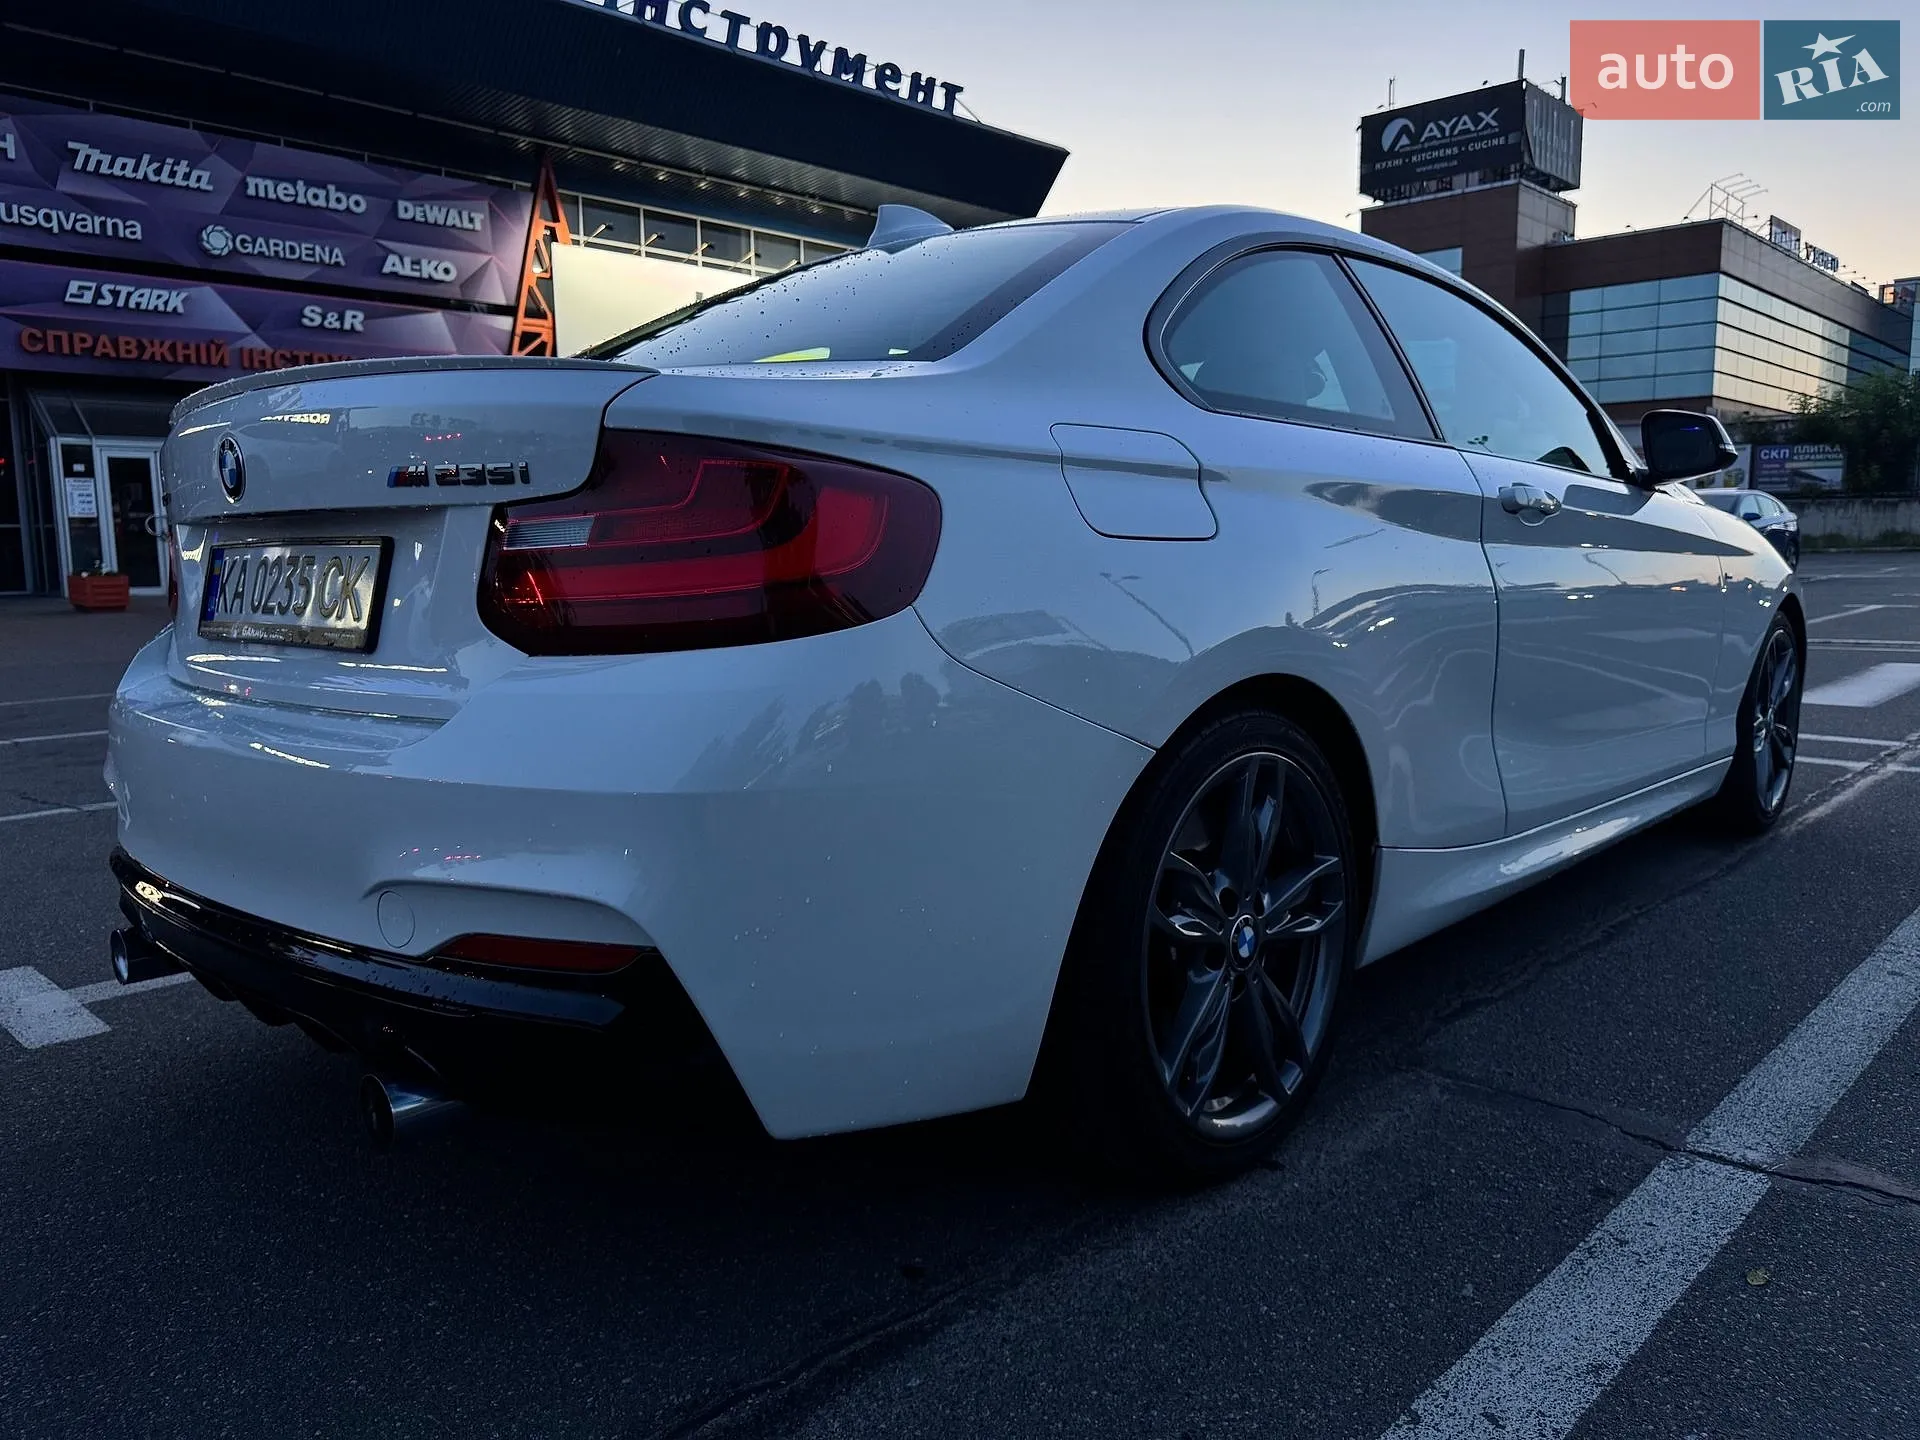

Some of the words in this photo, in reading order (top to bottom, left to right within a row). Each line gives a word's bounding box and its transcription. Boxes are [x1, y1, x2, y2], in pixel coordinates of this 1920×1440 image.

[603, 0, 964, 116] нструмент
[1420, 107, 1500, 143] AYAX
[1411, 146, 1459, 164] KITCHENS
[1468, 136, 1506, 152] CUCINE
[245, 175, 368, 215] metabo
[235, 234, 346, 267] GARDENA
[96, 283, 190, 313] STARK
[301, 305, 365, 332] S&R
[20, 327, 231, 369] СПРАВЖНІЙ
[1760, 448, 1790, 460] СКП
[1793, 444, 1841, 454] ПЛИТКА
[388, 461, 530, 487] M235i
[216, 554, 250, 614] KA
[250, 554, 317, 617] 0235
[319, 555, 371, 622] CK
